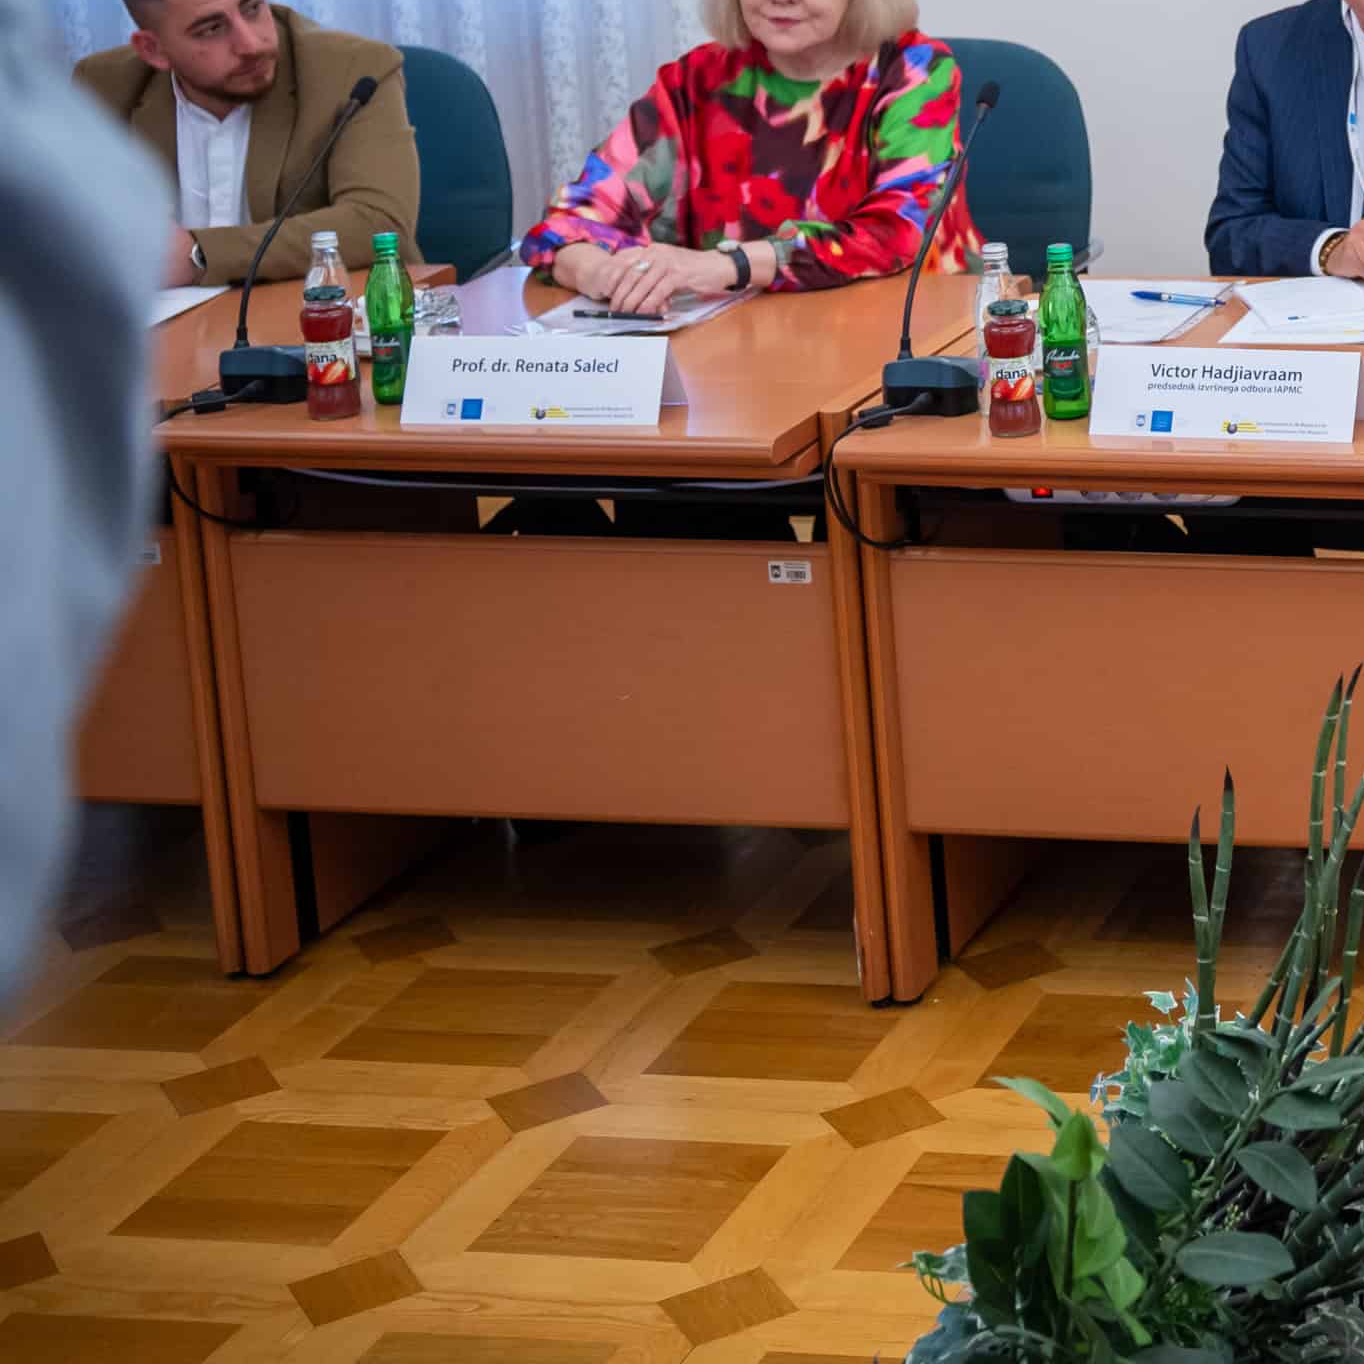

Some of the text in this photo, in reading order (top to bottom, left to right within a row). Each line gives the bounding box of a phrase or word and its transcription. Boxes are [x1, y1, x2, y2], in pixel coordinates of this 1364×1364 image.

[451, 358, 619, 373] Prof. dr. Renata Salecl
[996, 368, 1028, 380] dana
[1150, 363, 1303, 384] Victor Hadjiavraam
[1147, 381, 1195, 392] predsednik
[1240, 384, 1272, 394] odbora
